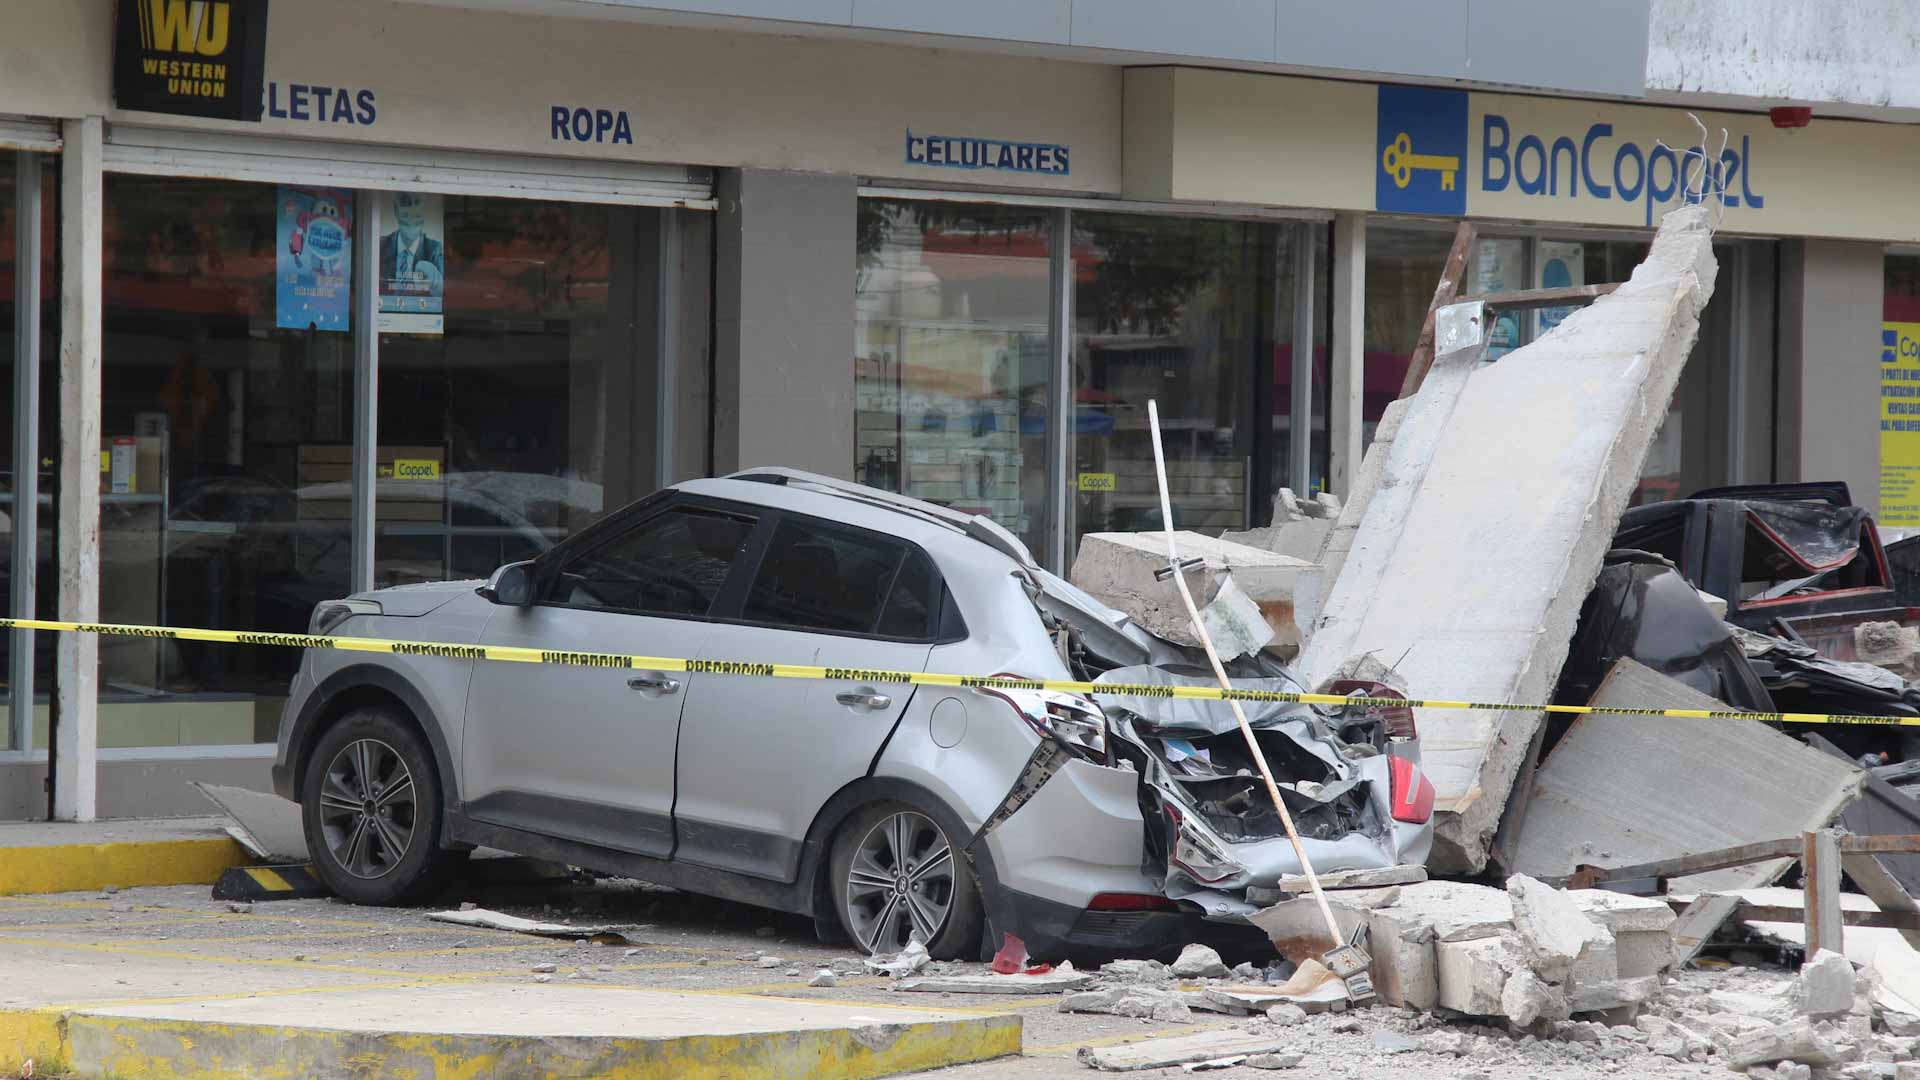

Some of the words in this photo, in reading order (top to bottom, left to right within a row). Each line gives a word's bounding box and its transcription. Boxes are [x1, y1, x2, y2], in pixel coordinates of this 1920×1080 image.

[143, 58, 226, 80] WESTERN
[167, 78, 225, 97] UNION
[261, 82, 376, 125] LETAS
[551, 105, 633, 145] ROPA
[908, 136, 1070, 175] CELULARES
[1482, 114, 1764, 226] BanCoppel
[399, 463, 434, 479] Coppel
